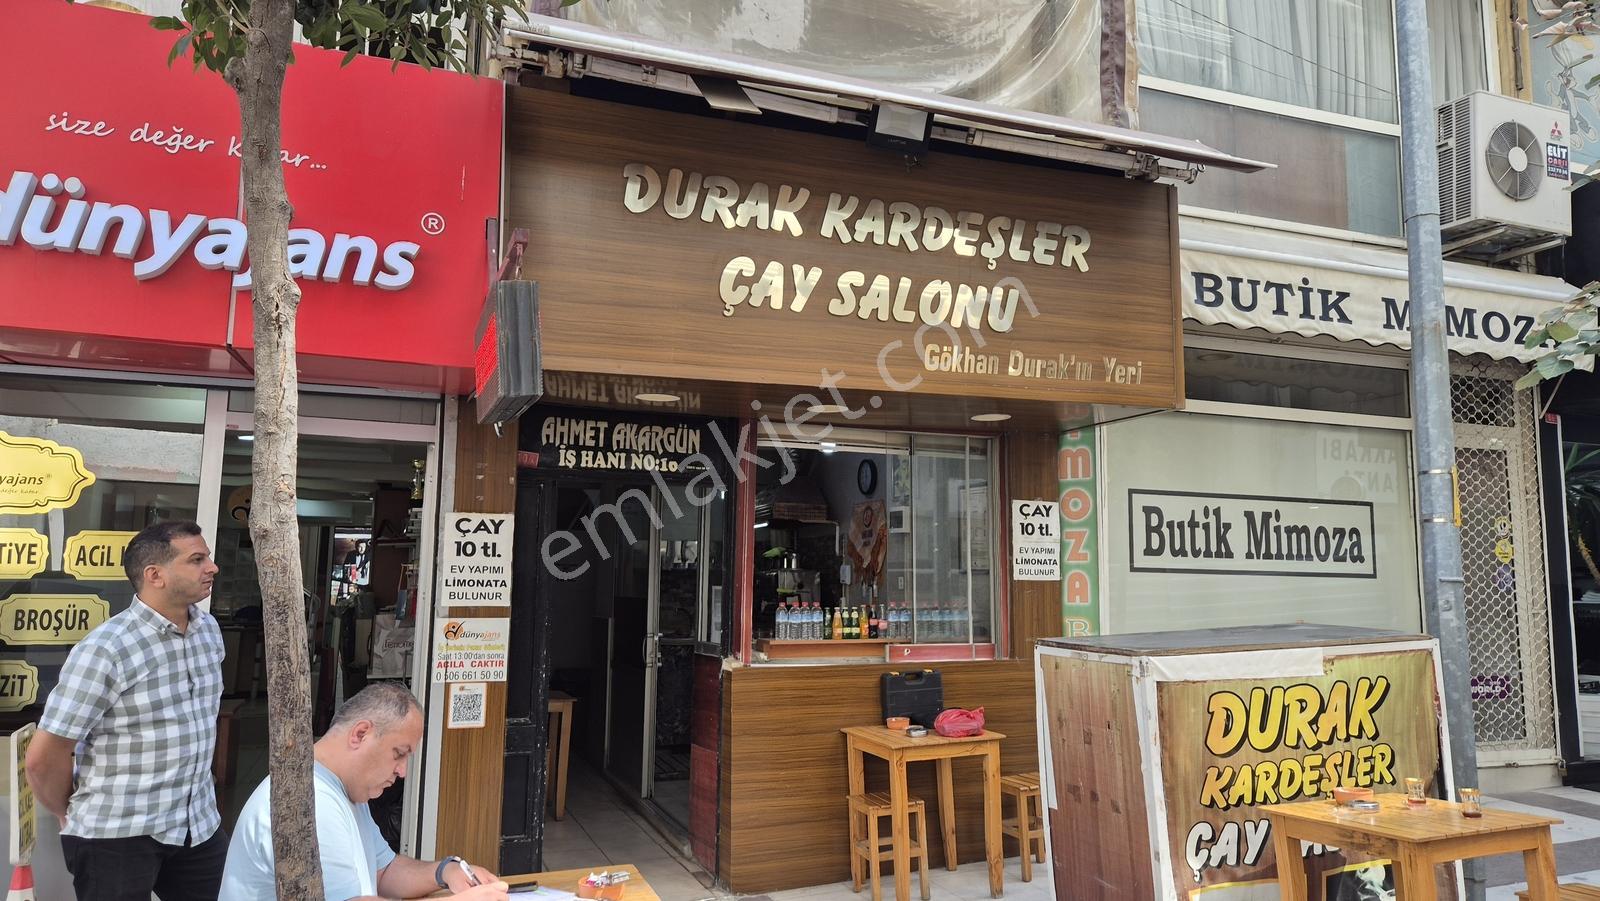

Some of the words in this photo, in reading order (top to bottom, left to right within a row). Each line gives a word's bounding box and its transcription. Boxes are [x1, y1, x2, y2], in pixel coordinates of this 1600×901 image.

[46, 111, 114, 137] size
[130, 122, 214, 154] değer
[228, 136, 327, 170] kar...
[0, 170, 421, 292] dünyaans
[622, 163, 810, 238] DURAK
[820, 192, 1092, 273] KARDEŞLER
[719, 256, 823, 318] ÇAY
[828, 270, 1021, 334] SALONU
[1191, 271, 1353, 325] BUTİK
[1381, 297, 1562, 350] MMOZ
[924, 343, 1000, 375] Gökhan
[1008, 350, 1094, 381] Durak'ın
[1102, 356, 1143, 385] Yeri
[541, 416, 609, 448] AHMET
[612, 422, 700, 455] AKARGÜN
[558, 444, 577, 469] İŞ
[581, 450, 626, 470] HANI
[455, 517, 505, 537] ÇAY
[1019, 503, 1053, 520] ÇAY
[1019, 522, 1036, 536] 10
[1038, 523, 1053, 536] tl.
[1142, 505, 1235, 559] Butik
[1243, 508, 1366, 564] Mimoza
[454, 541, 477, 557] 10
[481, 541, 502, 558] tl.
[1015, 557, 1058, 566] LİMONATA
[1031, 547, 1055, 555] YAPIMI
[445, 576, 507, 587] LİMONATA
[450, 565, 465, 573] EV
[468, 565, 504, 574] YAPIMI
[448, 591, 502, 600] BULUNUR
[13, 603, 90, 637] BROŞÜR
[435, 672, 442, 681] 0
[445, 671, 460, 680] 506
[462, 671, 477, 680] 661
[480, 671, 491, 679] 50
[493, 671, 504, 679] 90
[1205, 675, 1391, 757] DURAK
[1200, 743, 1397, 811] KARDEŞLER
[1185, 818, 1272, 883] ÇAY
